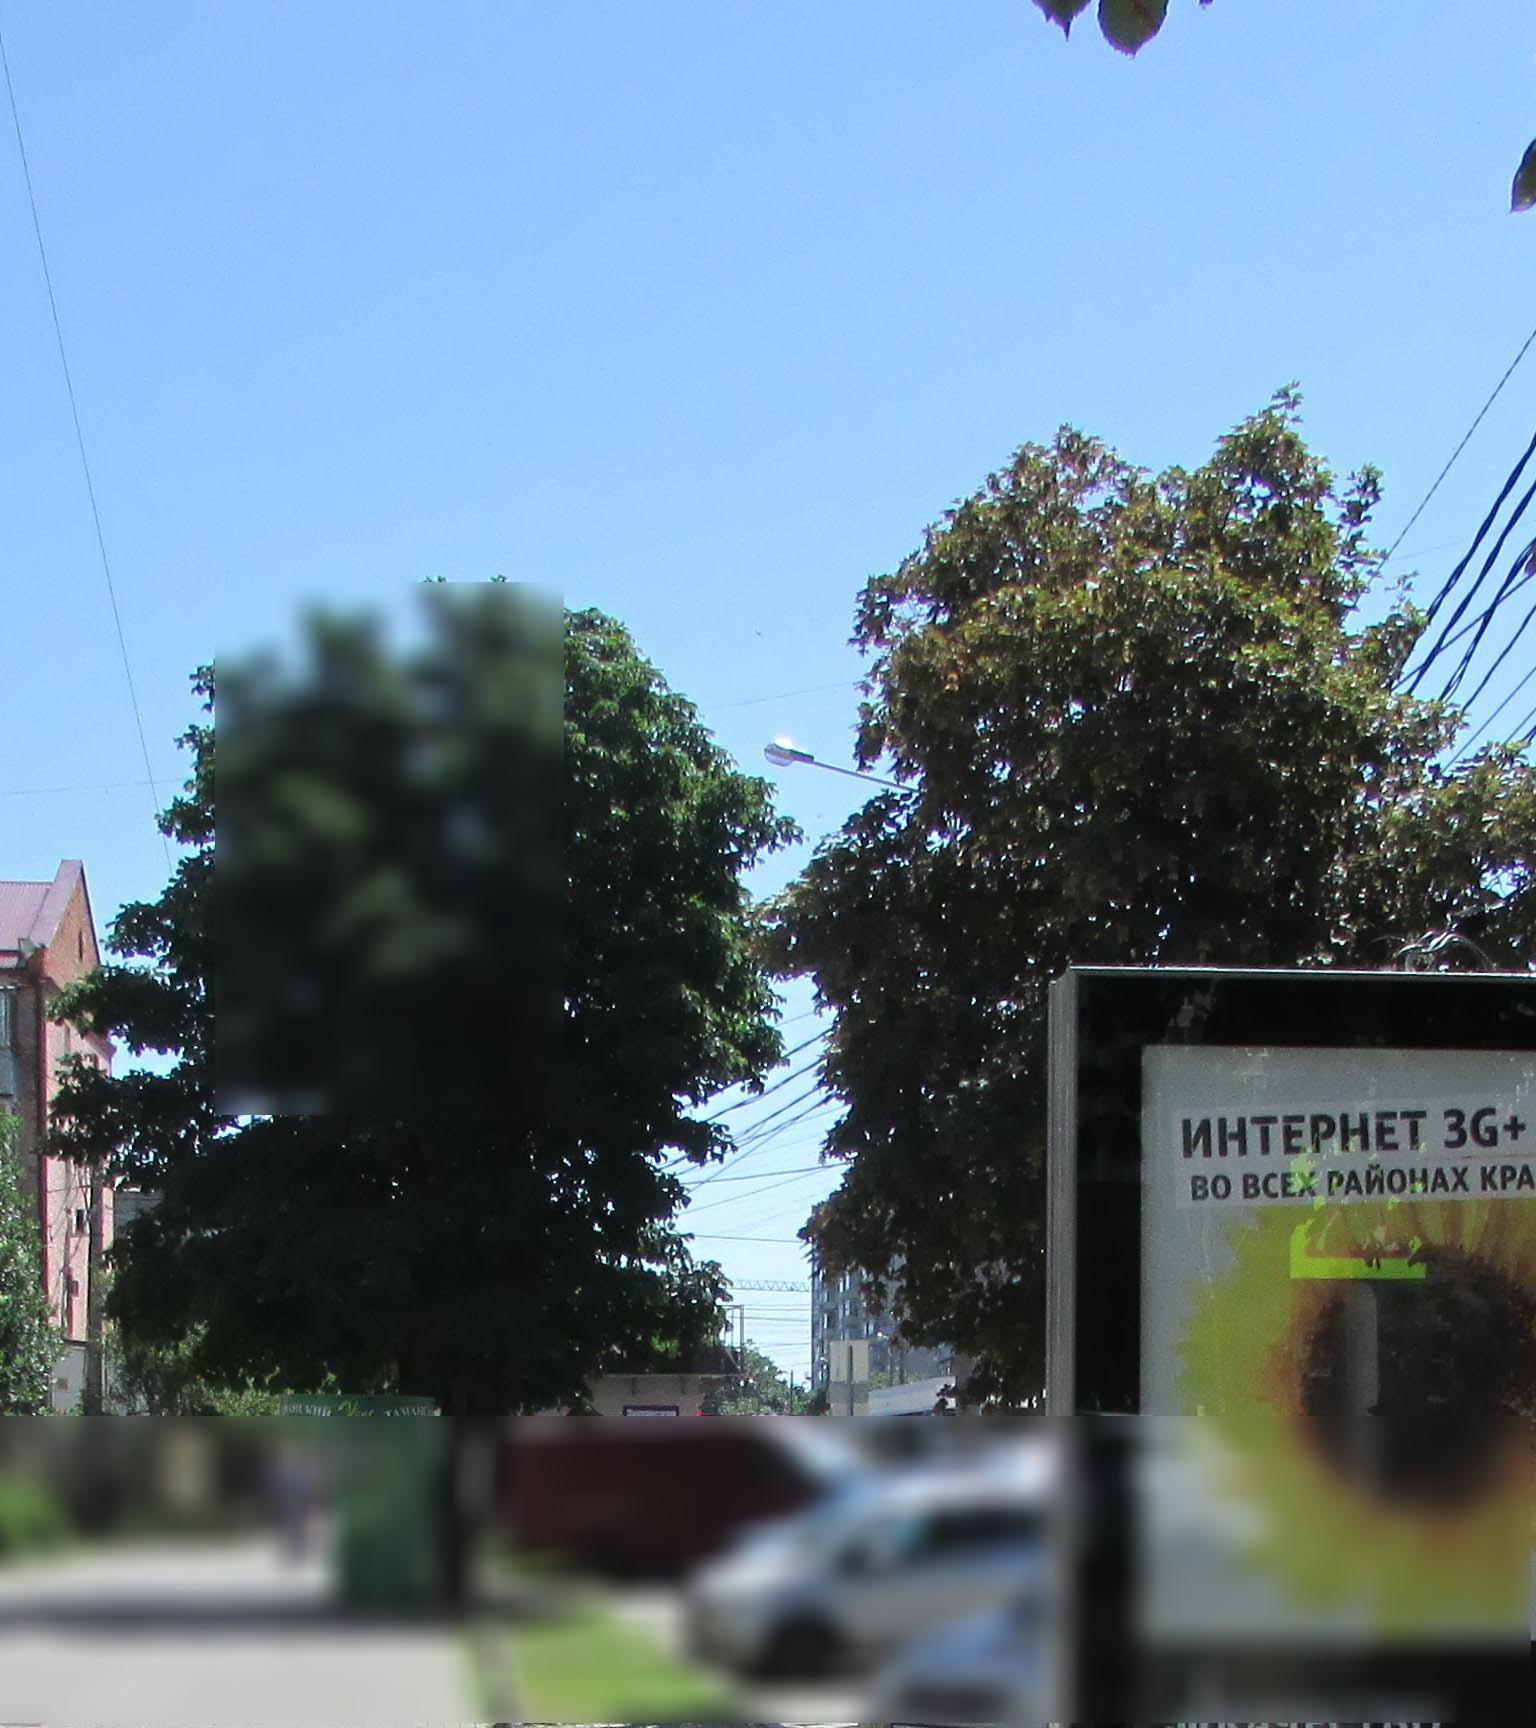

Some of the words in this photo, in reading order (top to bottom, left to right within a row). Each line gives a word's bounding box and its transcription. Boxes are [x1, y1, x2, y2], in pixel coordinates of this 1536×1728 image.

[1181, 1109, 1427, 1159] ИНТЕРНЕТ
[1443, 1106, 1527, 1150] 3G+
[1190, 1174, 1232, 1201] ВО
[1241, 1171, 1316, 1199] ВСЕХ
[1327, 1163, 1469, 1197] РАЙОНАХ
